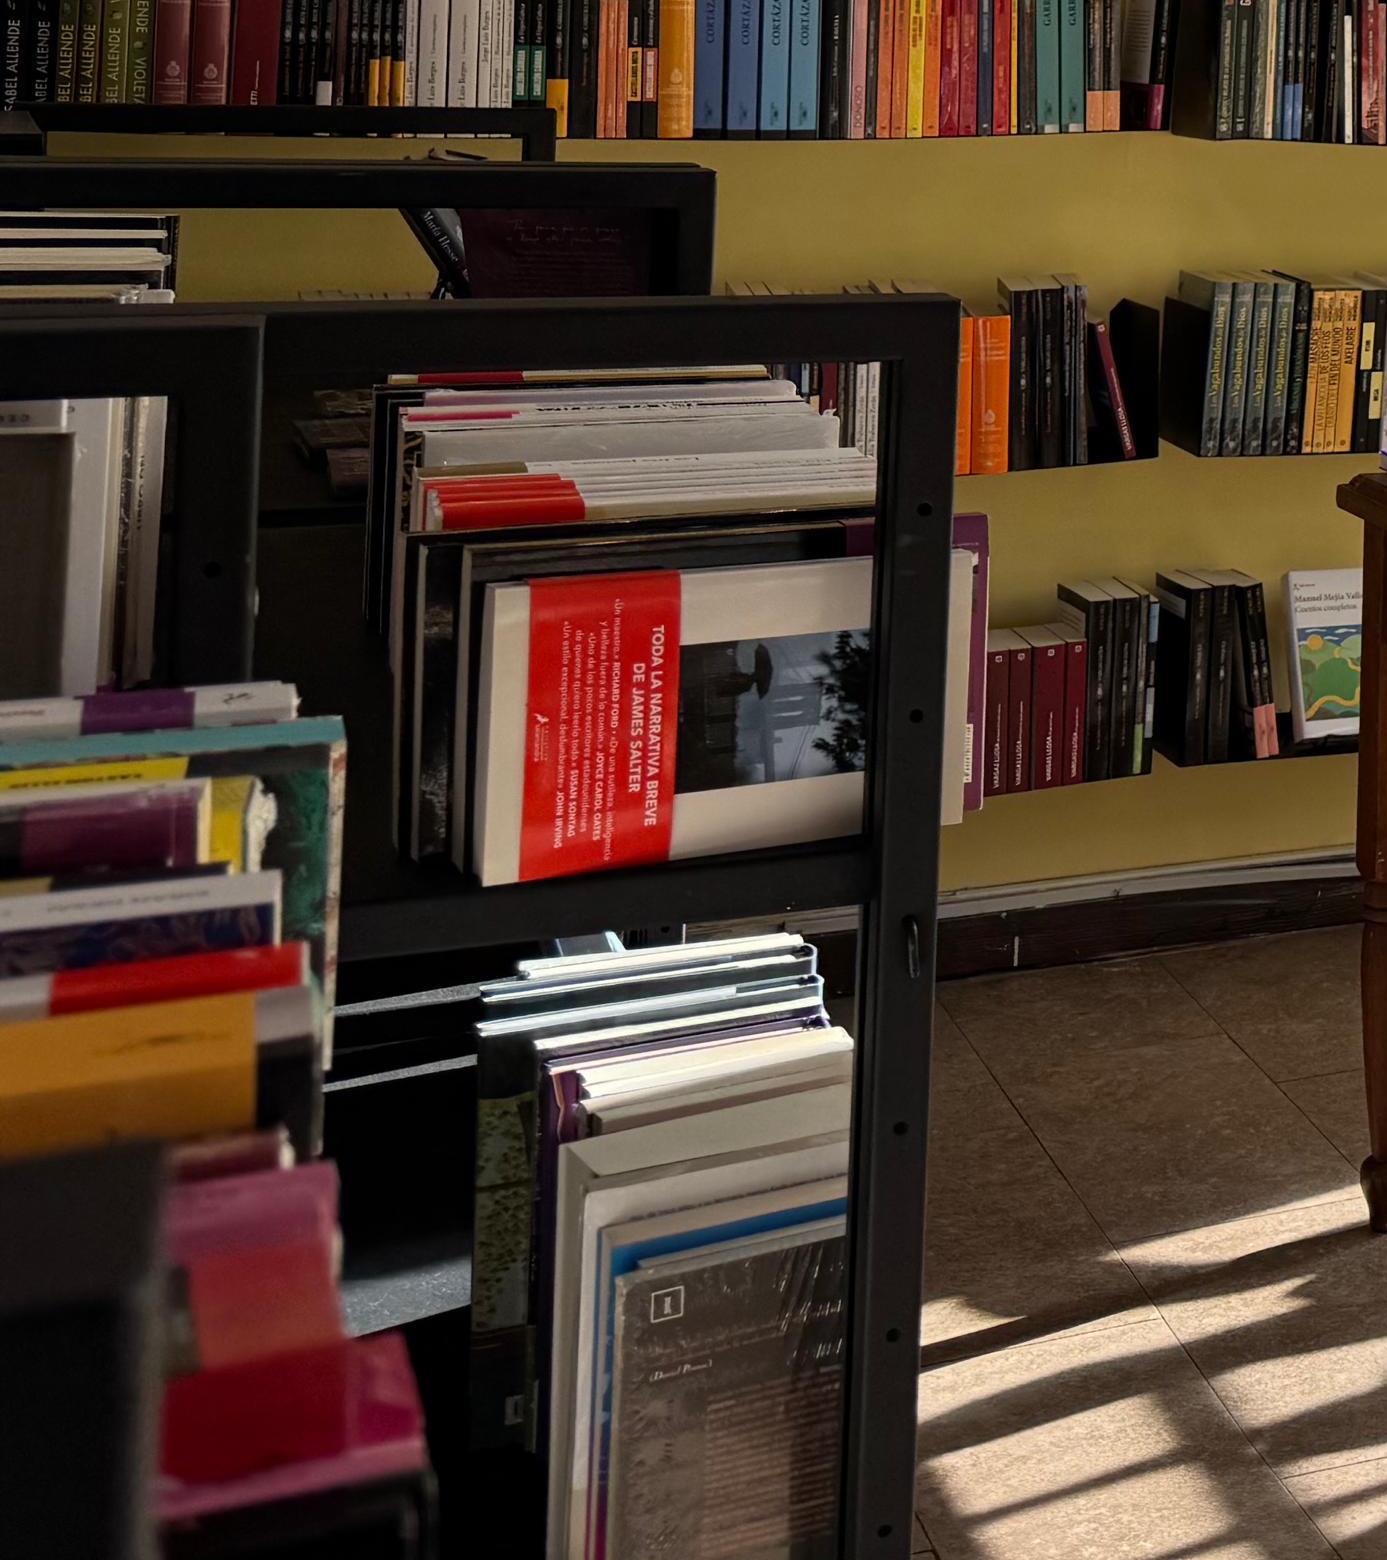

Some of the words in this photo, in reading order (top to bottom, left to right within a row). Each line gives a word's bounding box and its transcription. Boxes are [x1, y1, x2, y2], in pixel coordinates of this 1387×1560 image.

[6, 19, 21, 73] ALLENDE
[36, 20, 51, 74] ALLENDE
[59, 23, 75, 79] ALLENDE
[81, 23, 97, 79] ALLENDE
[106, 27, 121, 81] ALLENDE
[1207, 337, 1223, 398] Vagabundos
[1229, 337, 1244, 397] Vagabundos
[1251, 337, 1266, 398] Vagabundos
[1272, 337, 1287, 397] Vagabundos
[600, 628, 610, 660] belleza
[651, 624, 666, 668] TODA
[586, 670, 595, 685] los
[597, 686, 607, 700] de
[598, 661, 609, 686] fuera
[611, 661, 621, 702] RICHARD
[632, 662, 646, 684] DE
[649, 670, 663, 690] LA
[610, 703, 621, 728] FORD
[630, 686, 645, 737] JAMES
[646, 692, 663, 777] NARRATIVA
[568, 768, 578, 799] SUSAN
[595, 750, 606, 780] JOYCE
[628, 739, 643, 793] SALTER
[593, 780, 604, 812] CAROL
[644, 779, 658, 828] BREVE
[591, 811, 603, 842] OATES
